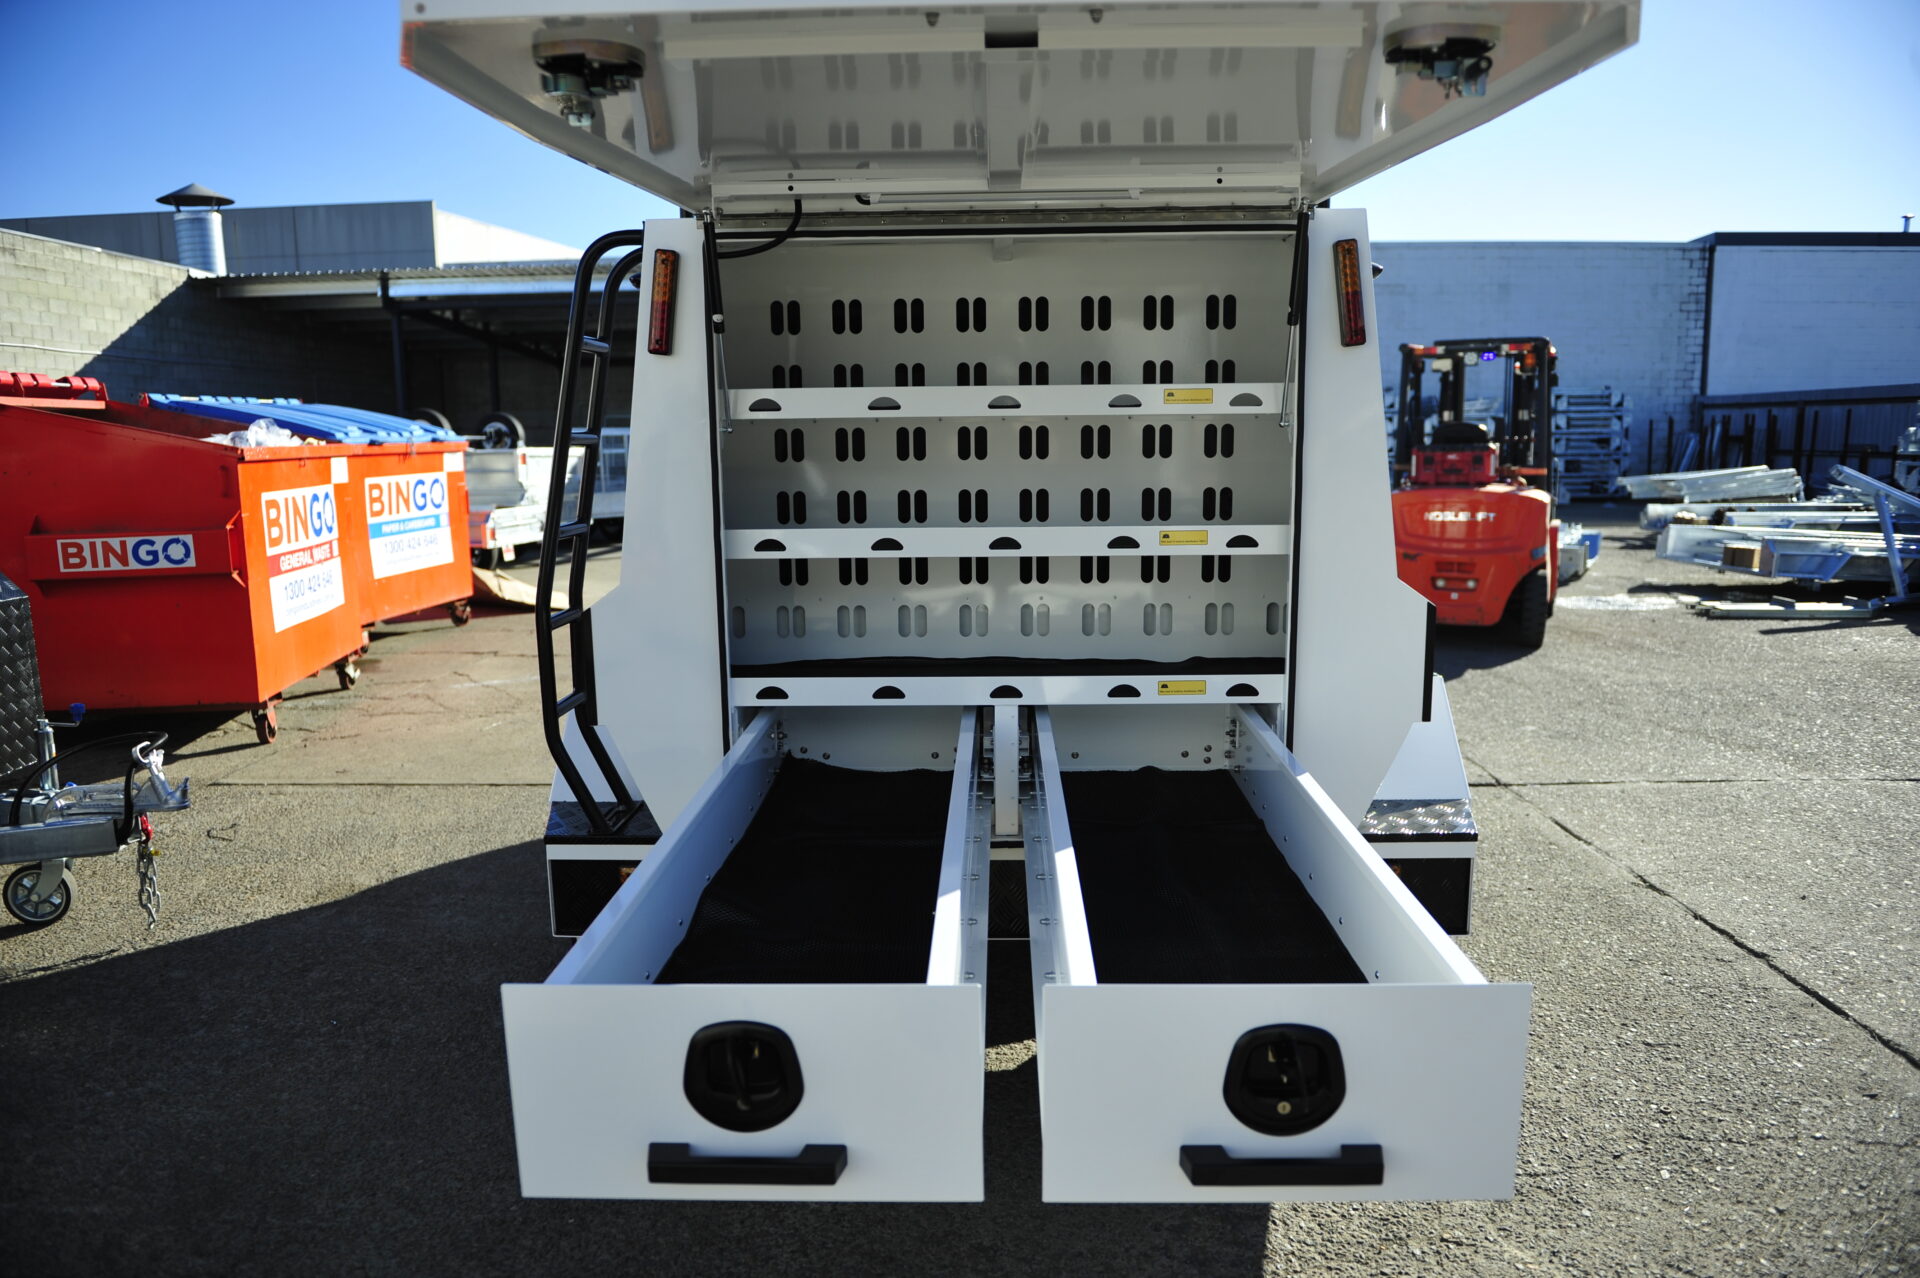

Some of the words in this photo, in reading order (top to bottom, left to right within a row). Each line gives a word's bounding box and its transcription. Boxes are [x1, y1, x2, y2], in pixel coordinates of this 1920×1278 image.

[368, 479, 445, 518] BINGO
[265, 491, 334, 548] BINGO
[60, 537, 191, 569] BINGO
[280, 548, 313, 571] GENERAL
[312, 543, 331, 563] WASTE
[284, 579, 305, 600] 1300
[308, 574, 321, 592] 424
